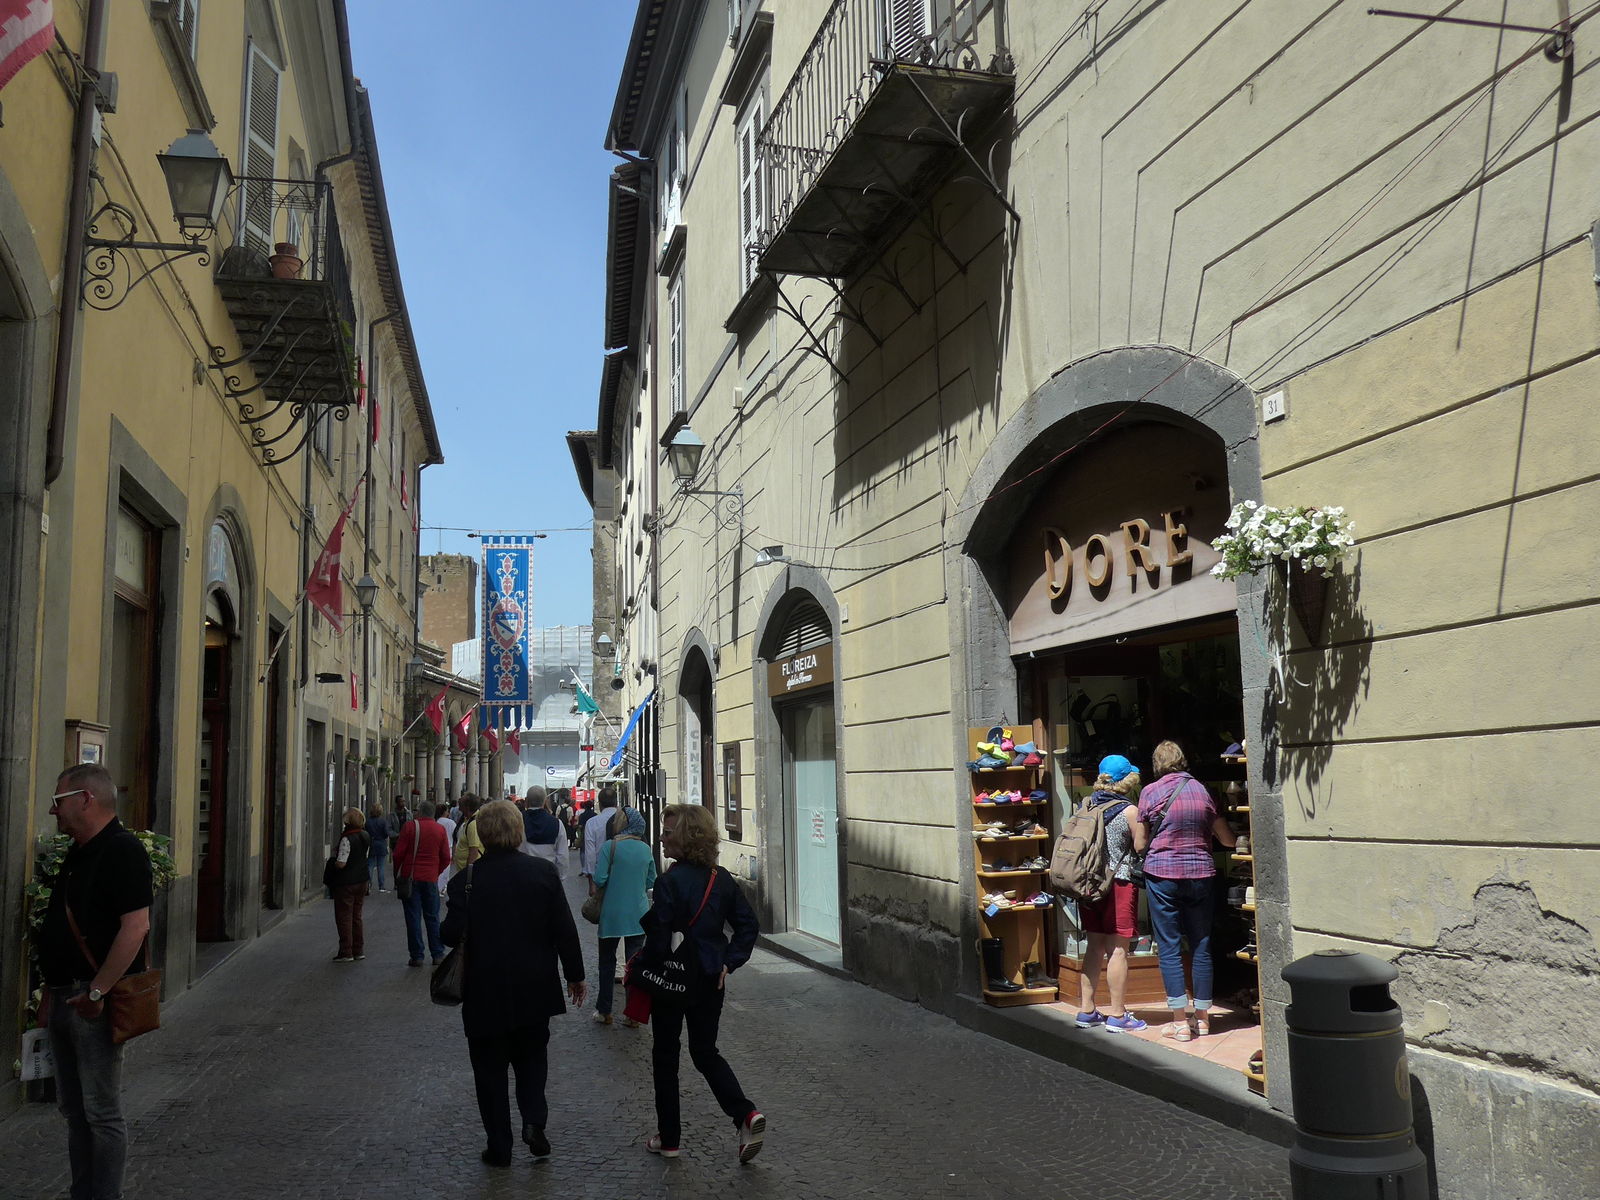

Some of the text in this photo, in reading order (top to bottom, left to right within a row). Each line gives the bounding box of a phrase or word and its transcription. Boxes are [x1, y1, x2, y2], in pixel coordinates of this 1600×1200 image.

[1268, 399, 1278, 415] 31
[1043, 506, 1193, 600] DORE
[782, 654, 817, 676] FLOREIZA
[642, 969, 686, 992] CAMPGLIO
